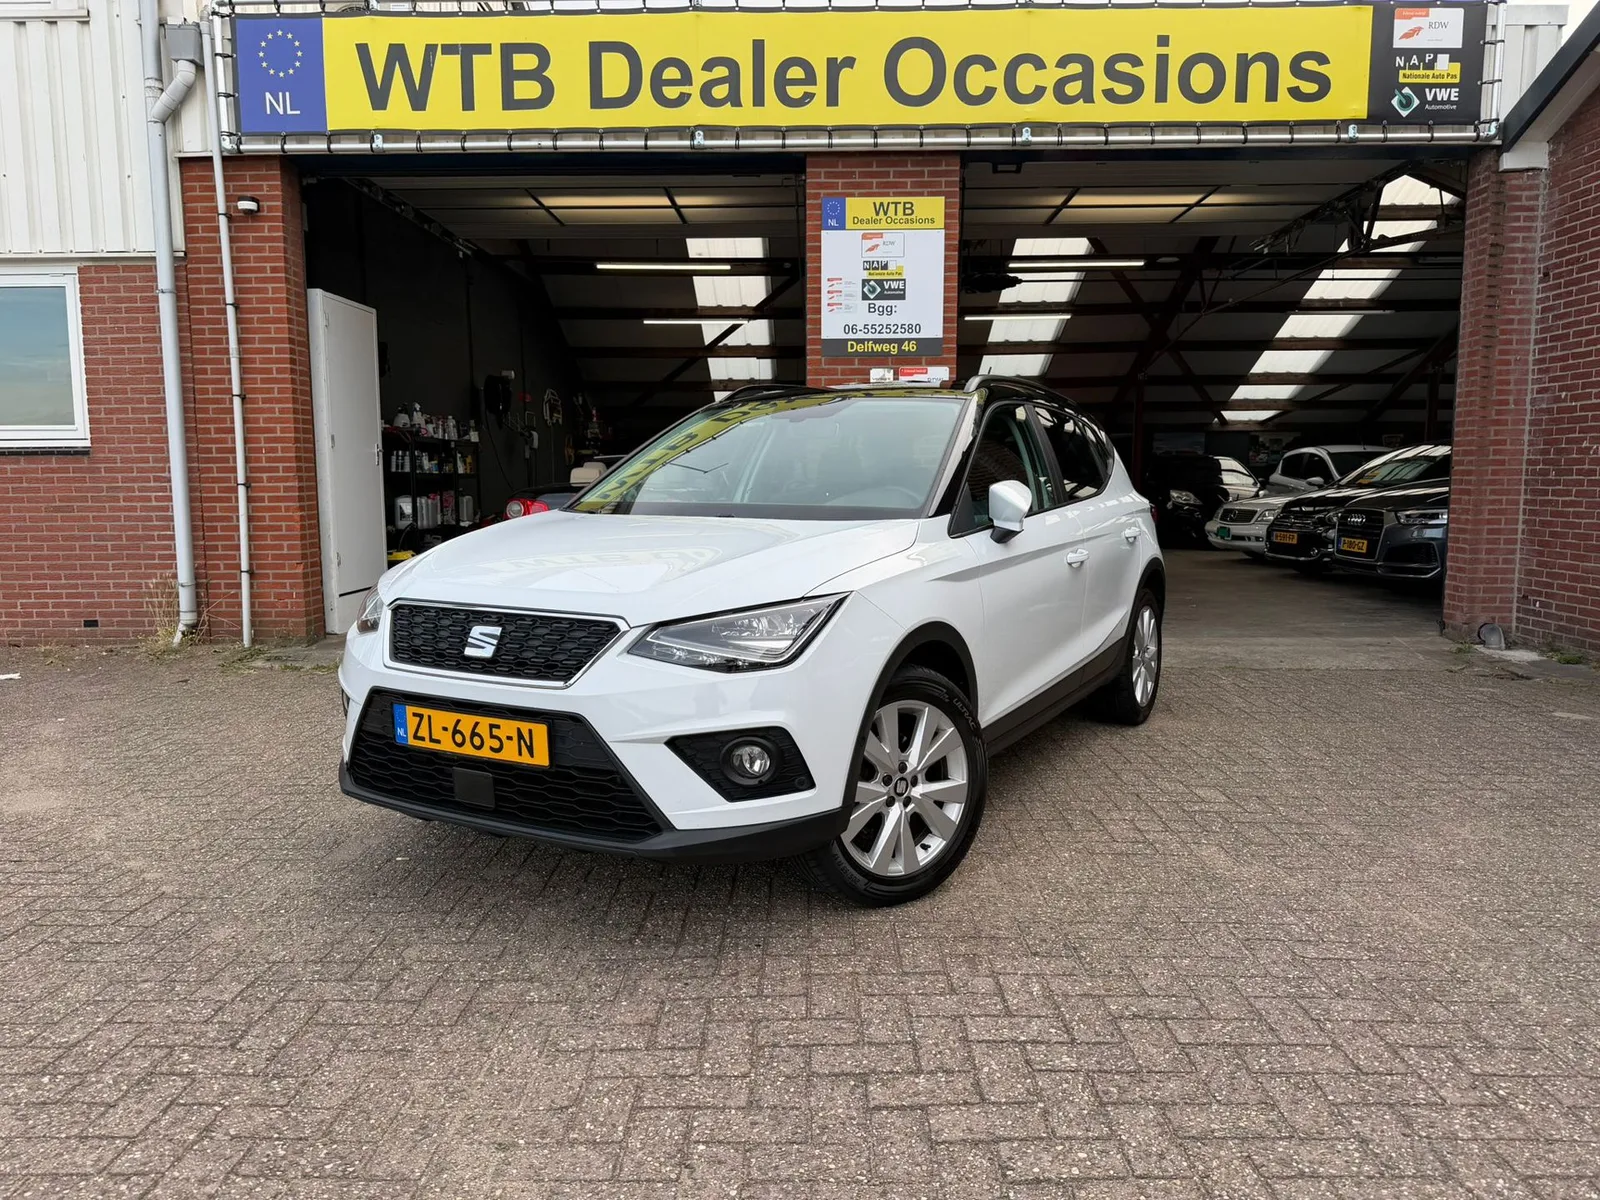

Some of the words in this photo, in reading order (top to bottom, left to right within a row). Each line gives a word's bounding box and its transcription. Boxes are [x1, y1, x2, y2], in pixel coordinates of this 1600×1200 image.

[1428, 21, 1449, 30] RDW
[354, 42, 555, 112] WTB
[588, 38, 857, 110] Dealer
[883, 35, 1332, 108] Occasions
[1402, 72, 1430, 80] Nationale
[1431, 72, 1445, 80] Auto
[1446, 72, 1458, 80] Pas
[1424, 88, 1460, 101] VWE
[265, 92, 301, 115] NL
[873, 201, 915, 216] WTB
[827, 219, 840, 227] NL
[852, 216, 882, 225] Dealer
[885, 216, 936, 225] Occasions
[883, 280, 905, 289] VWE
[867, 303, 898, 316] Bgg:
[843, 323, 922, 335] 06-55252580
[847, 341, 898, 354] Delfweg
[901, 340, 917, 352] 46
[397, 727, 407, 738] NL
[411, 712, 535, 759] ZL-665-N
